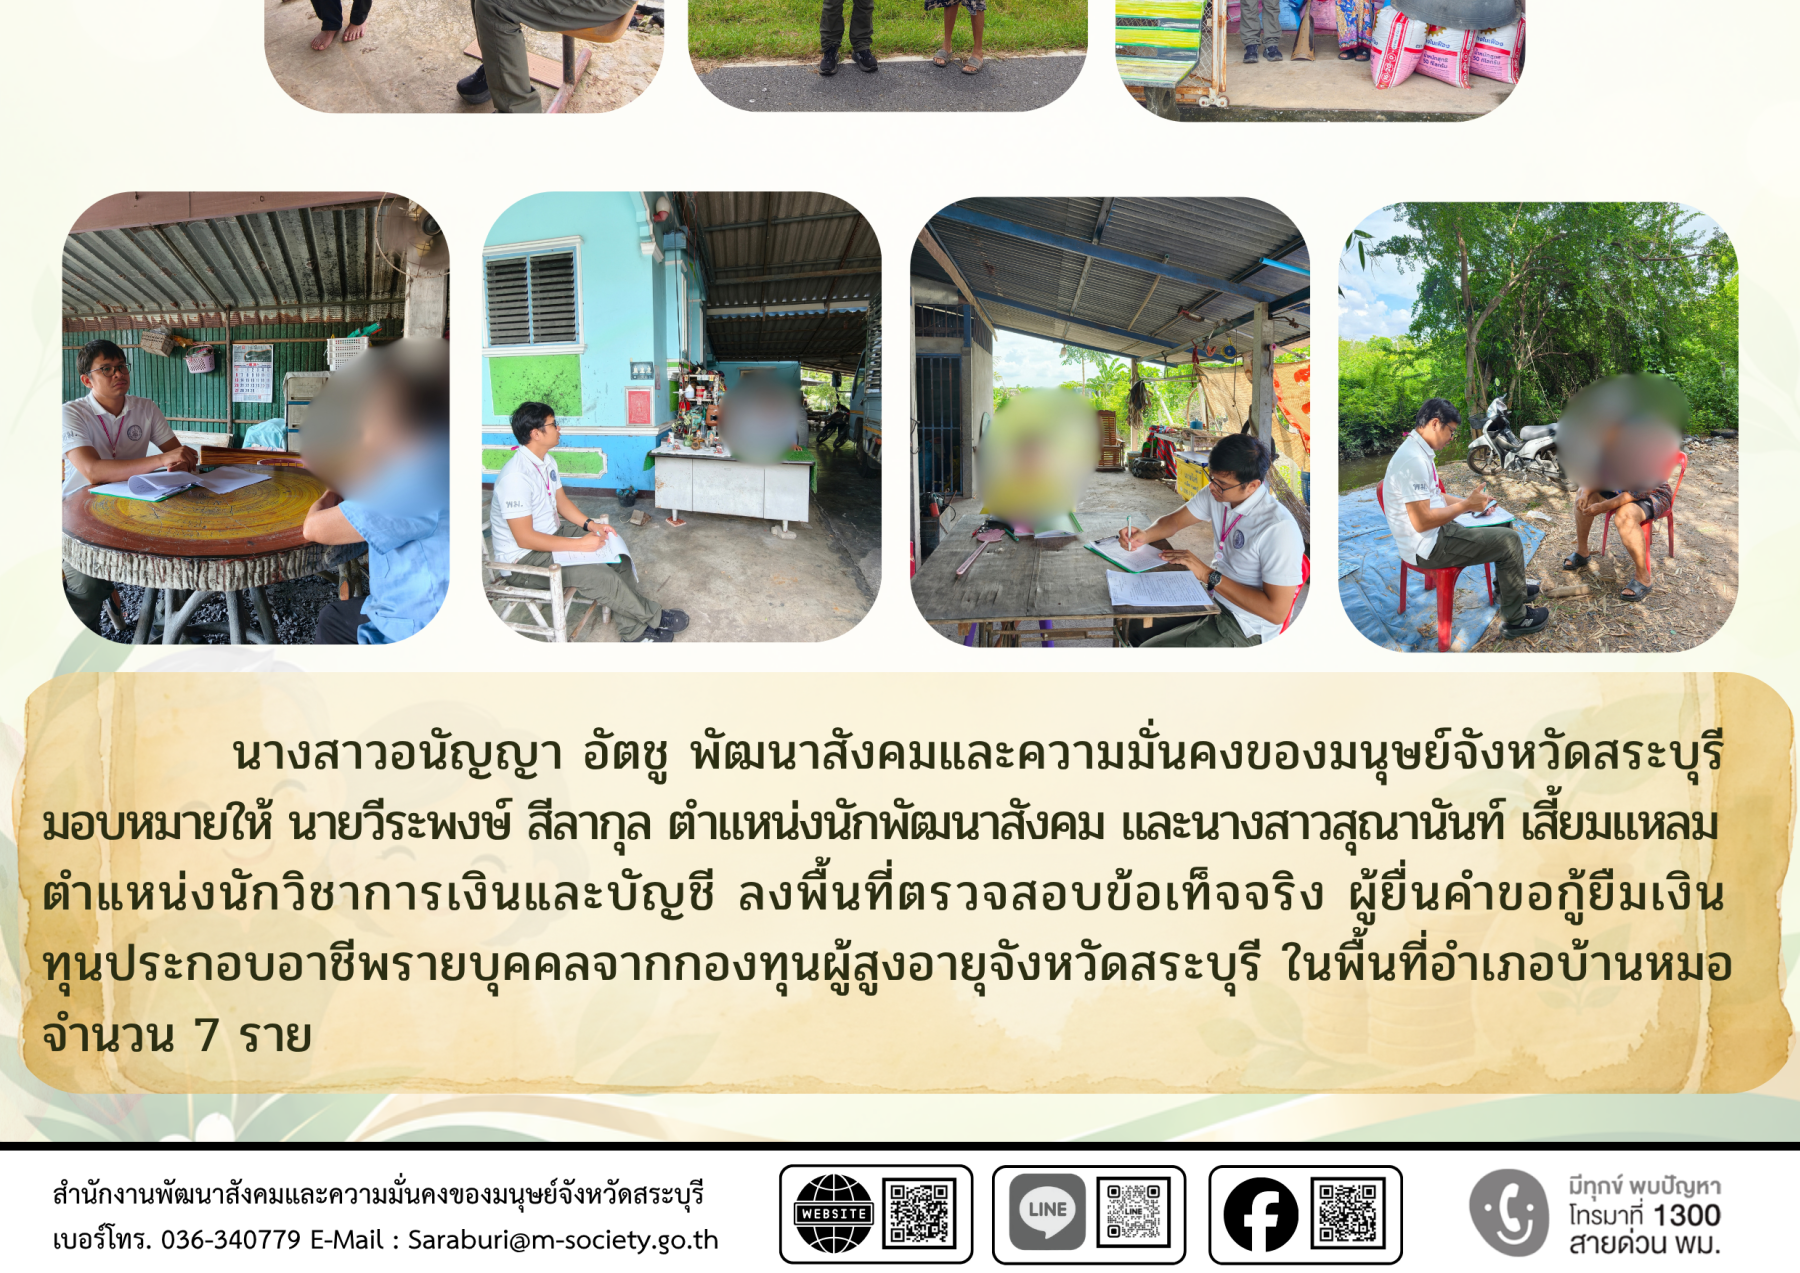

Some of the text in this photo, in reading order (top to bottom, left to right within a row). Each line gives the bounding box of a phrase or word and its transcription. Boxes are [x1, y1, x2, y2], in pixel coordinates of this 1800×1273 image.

[505, 500, 524, 509] พม.
[232, 718, 1725, 787] นางสาวอนัญญา อัตชู พัฒนาสังคมและความมั่นคงของมนุษย์จังหวัดสระบุรี
[43, 785, 1718, 856] มอบหมายให้ นายวีระพงษ์ สีลากุล ตำแหน่งนักพัฒนาสังคม และนางสาวสุณานันท์ เสี้ยมแหลม
[43, 856, 1724, 926] ตำแหน่งนักวิชาการเงินและบัญชี ลงพื้นที่ตรวจสอบข้อเท็จจริง ผู้ยื่นคำขอกู้ยืมเงิน
[42, 926, 1732, 997] ทุนประกอบอาชีพรายบุคคลจากกองทุนผู้สูงอายุจังหวัดสระบุรี ในพื้นที่อำเภอบ้านหมอ
[42, 1010, 311, 1053] จำนวน 7 ราย
[53, 1172, 704, 1214] สำนักงานพัฒนาสังคมและความมั่นคงของมนุษย์จังหวัดสระบุรี
[1569, 1173, 1722, 1202] มีทุกข์ พบปัญหา
[801, 1208, 868, 1221] WEBSITE
[1029, 1202, 1067, 1217] LINE
[1569, 1198, 1721, 1227] โทรมาที่ 1300
[54, 1222, 151, 1250] เบอร์โทร.
[161, 1228, 301, 1250] 036-340779
[311, 1228, 384, 1250] E-Mail
[408, 1228, 718, 1255] Saraburi@m-society.go.th
[1569, 1228, 1721, 1255] สายด่วน พม.
